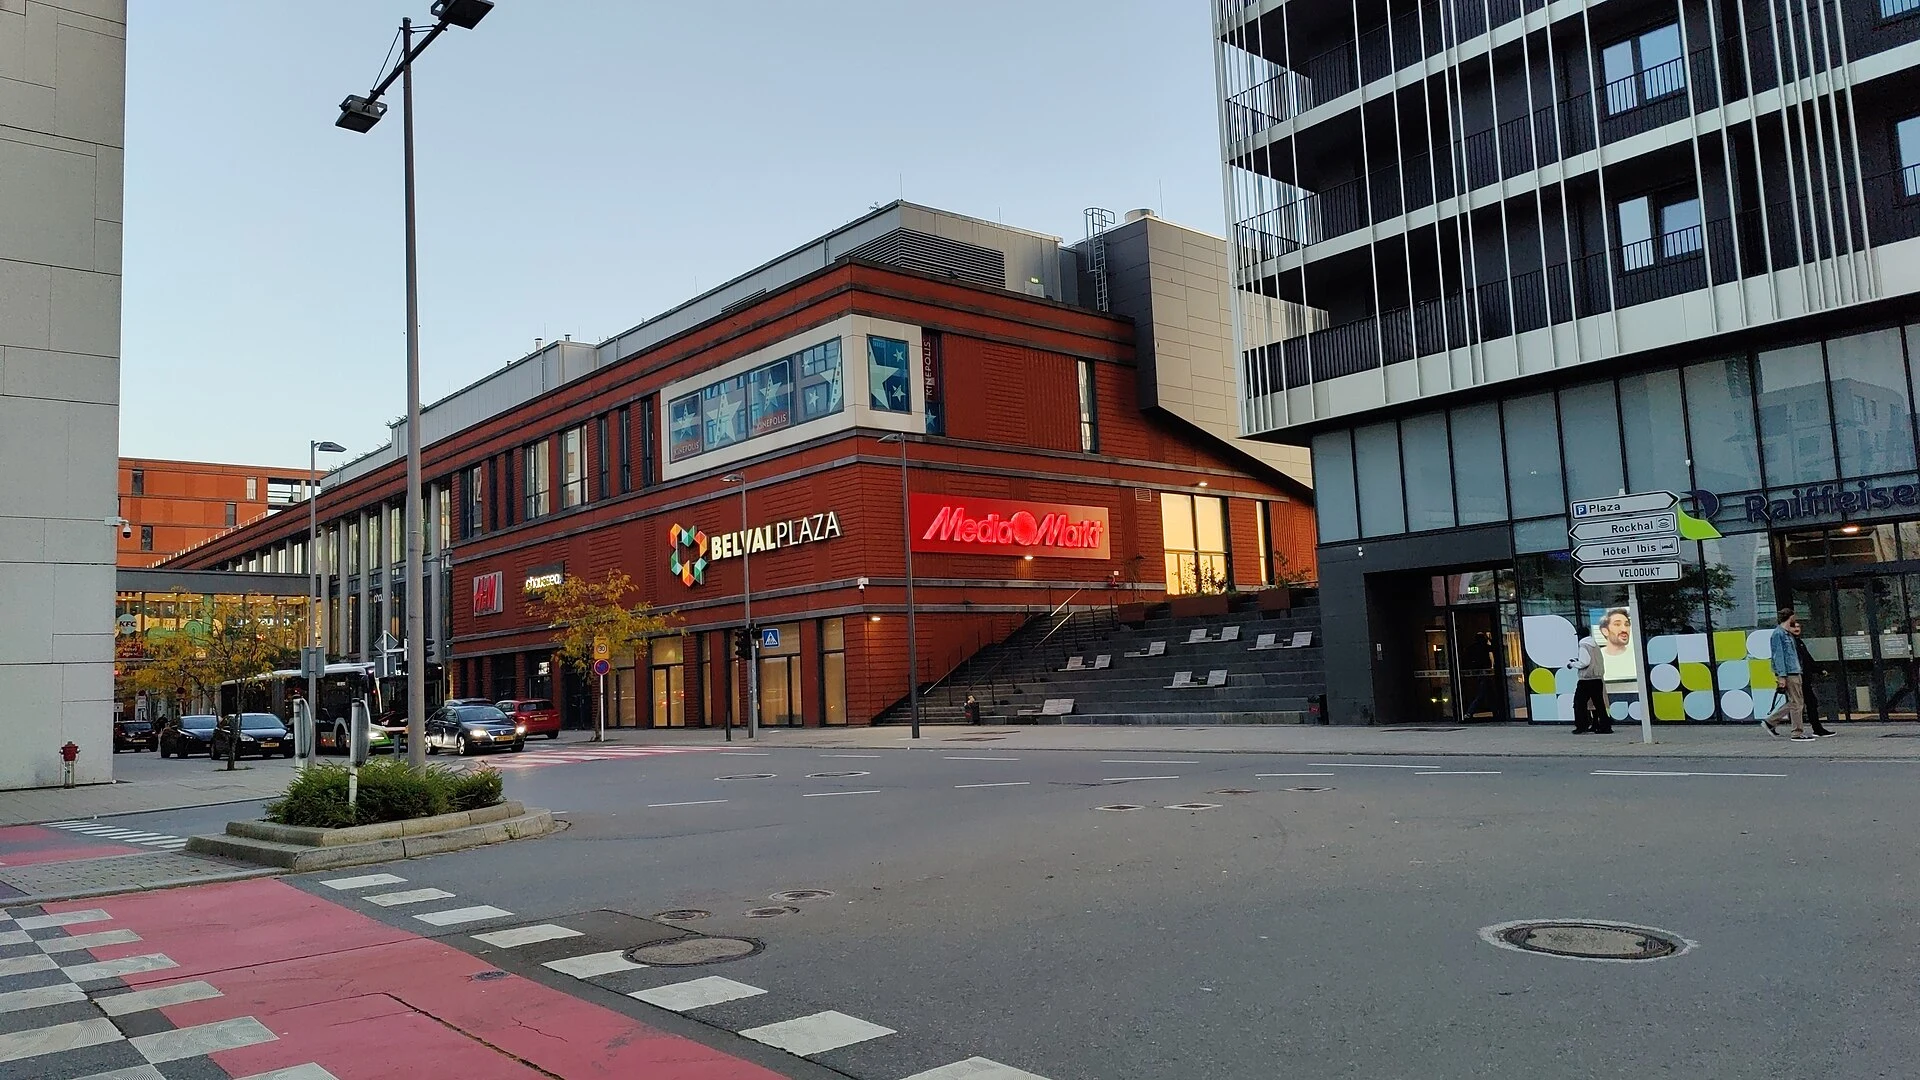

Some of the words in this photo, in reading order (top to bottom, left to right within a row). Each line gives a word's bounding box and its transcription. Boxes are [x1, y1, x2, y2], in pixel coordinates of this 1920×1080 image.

[924, 341, 933, 396] KINEPOLIS
[756, 413, 787, 430] KINEPOLIS
[674, 441, 700, 455] KINEPOLIS
[1589, 503, 1621, 513] Plaza
[1745, 480, 1919, 523] Raiffeise
[1611, 521, 1654, 534] Rockhal
[1602, 545, 1630, 556] Hôtel
[1637, 542, 1657, 552] Ibis
[1619, 567, 1660, 578] VELODUKT
[119, 620, 137, 628] KFC
